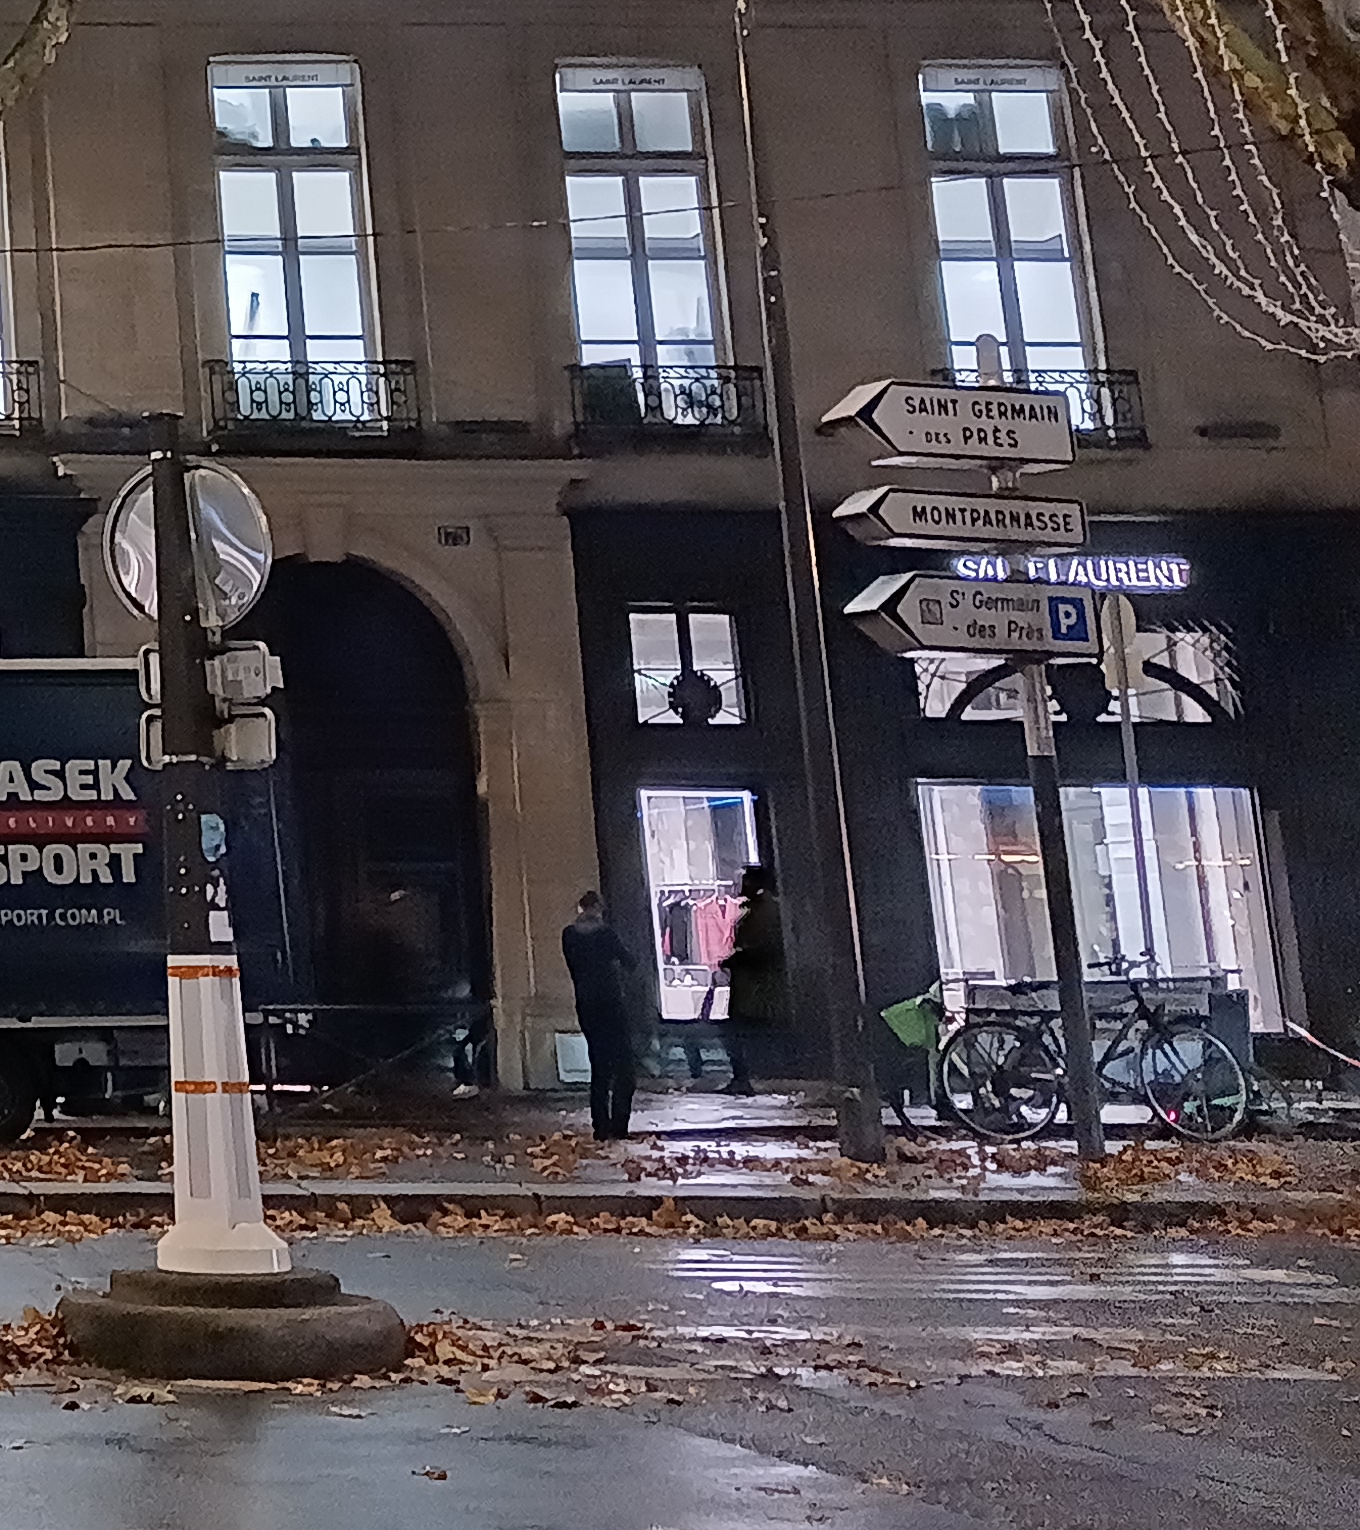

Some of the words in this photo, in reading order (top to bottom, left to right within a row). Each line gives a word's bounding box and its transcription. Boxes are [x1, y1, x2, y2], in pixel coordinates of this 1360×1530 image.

[905, 395, 959, 417] SAINT
[971, 400, 1059, 423] GERMAIN
[924, 431, 952, 445] DES
[911, 504, 1074, 534] MONTPARNASSE
[972, 592, 1041, 614] Germain
[1057, 603, 1077, 634] P
[966, 620, 997, 639] des
